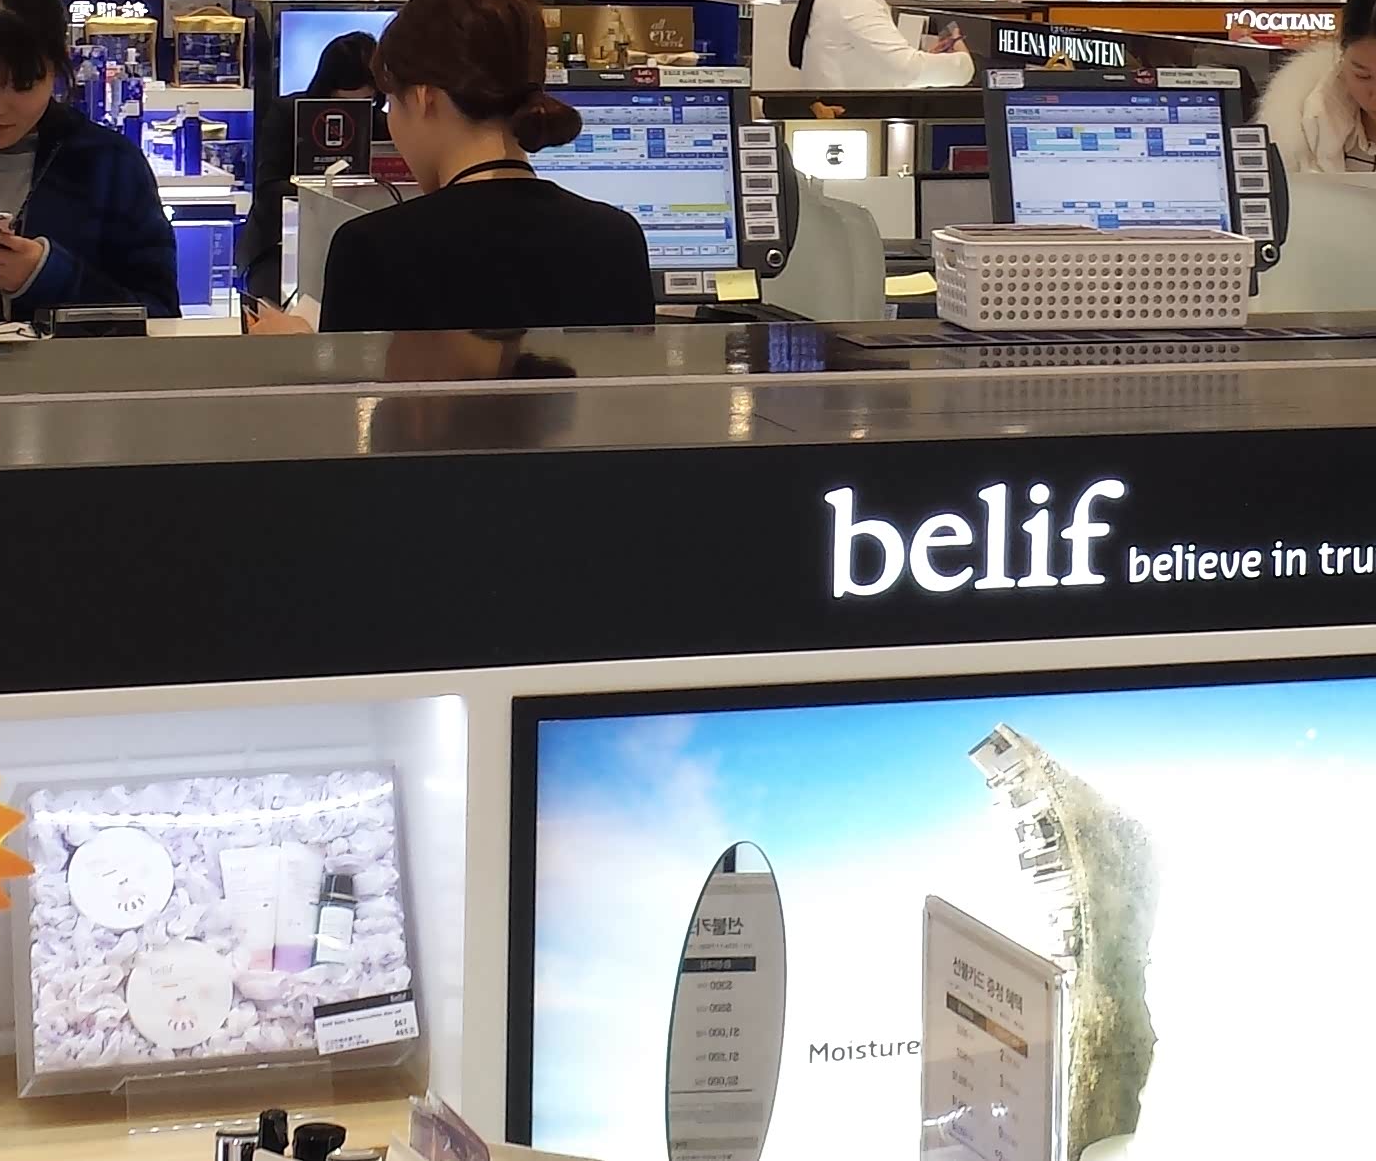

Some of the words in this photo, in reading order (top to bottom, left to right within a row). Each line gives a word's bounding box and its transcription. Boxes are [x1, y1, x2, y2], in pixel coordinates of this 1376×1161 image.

[998, 28, 1047, 57] HELENA
[1048, 34, 1125, 68] RUBINSTEIN
[824, 478, 1126, 599] belif
[1128, 544, 1262, 584] believe
[1272, 540, 1308, 577] in
[809, 1040, 921, 1064] Moisture
